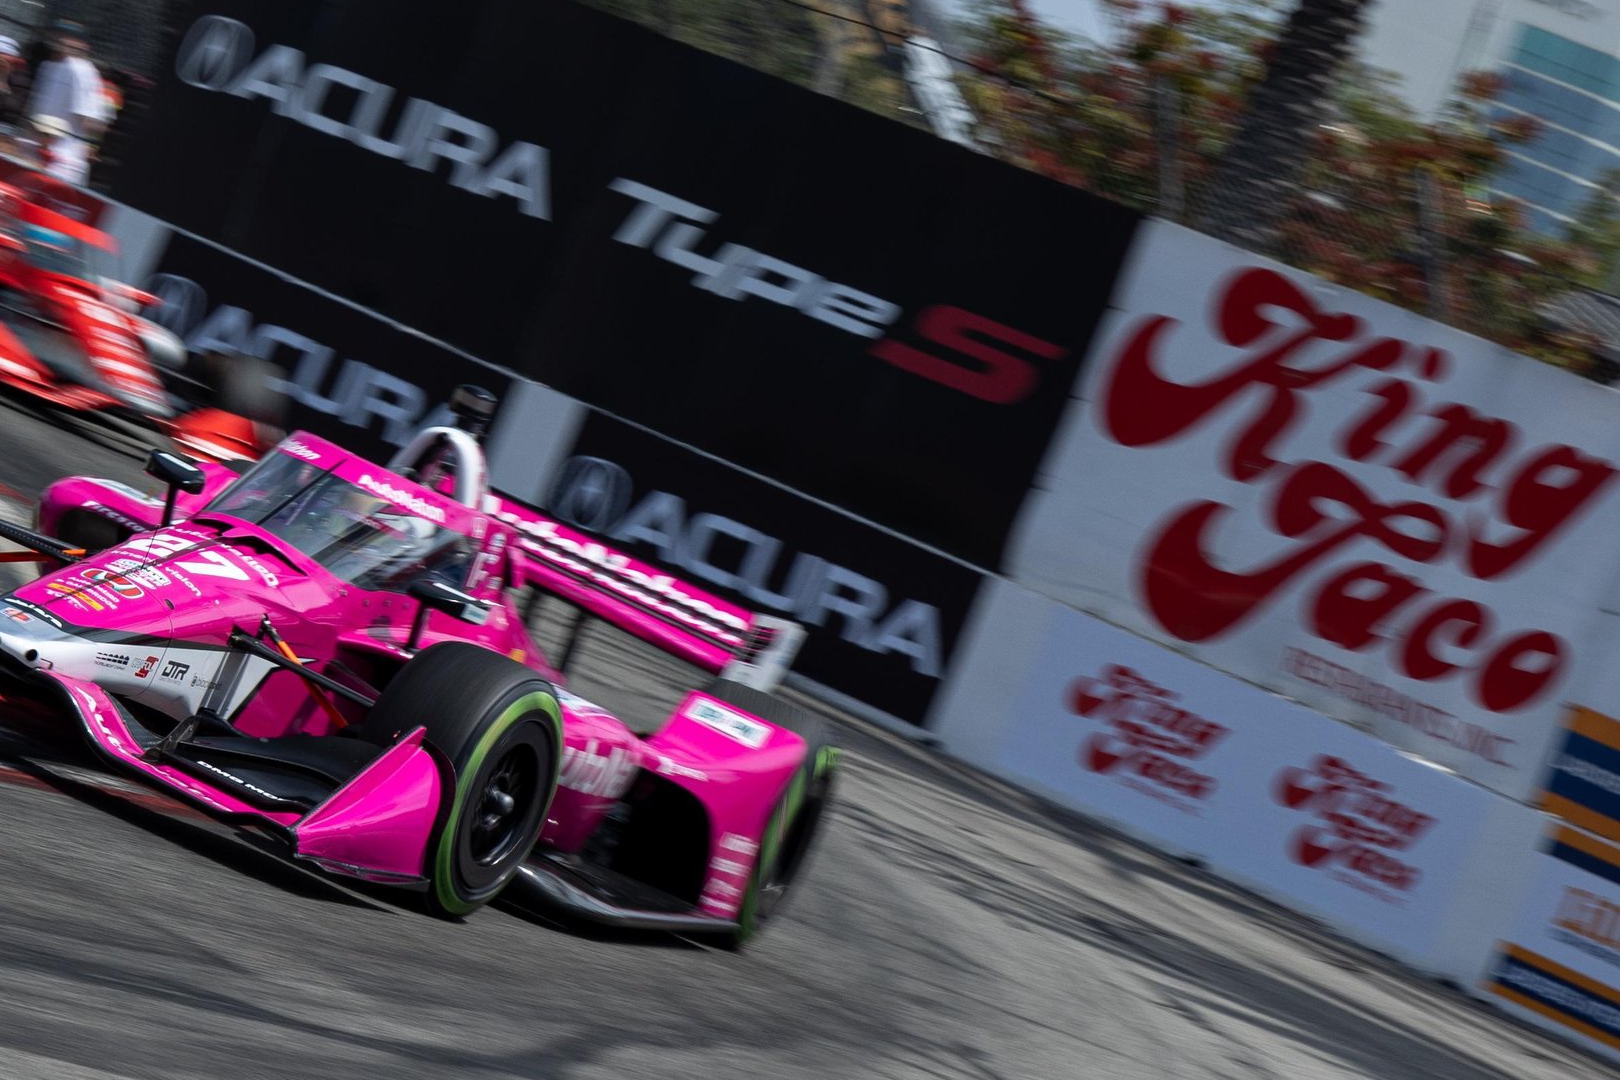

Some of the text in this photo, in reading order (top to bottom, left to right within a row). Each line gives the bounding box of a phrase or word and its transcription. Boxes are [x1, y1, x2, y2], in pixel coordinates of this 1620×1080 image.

[227, 42, 554, 222] ACURA
[867, 304, 1070, 404] S
[1094, 266, 1620, 582] King
[118, 532, 251, 582] 27
[357, 474, 447, 523] AutoNation
[164, 565, 203, 598] vision
[608, 489, 945, 679] ACURA
[1132, 458, 1571, 714] Taco
